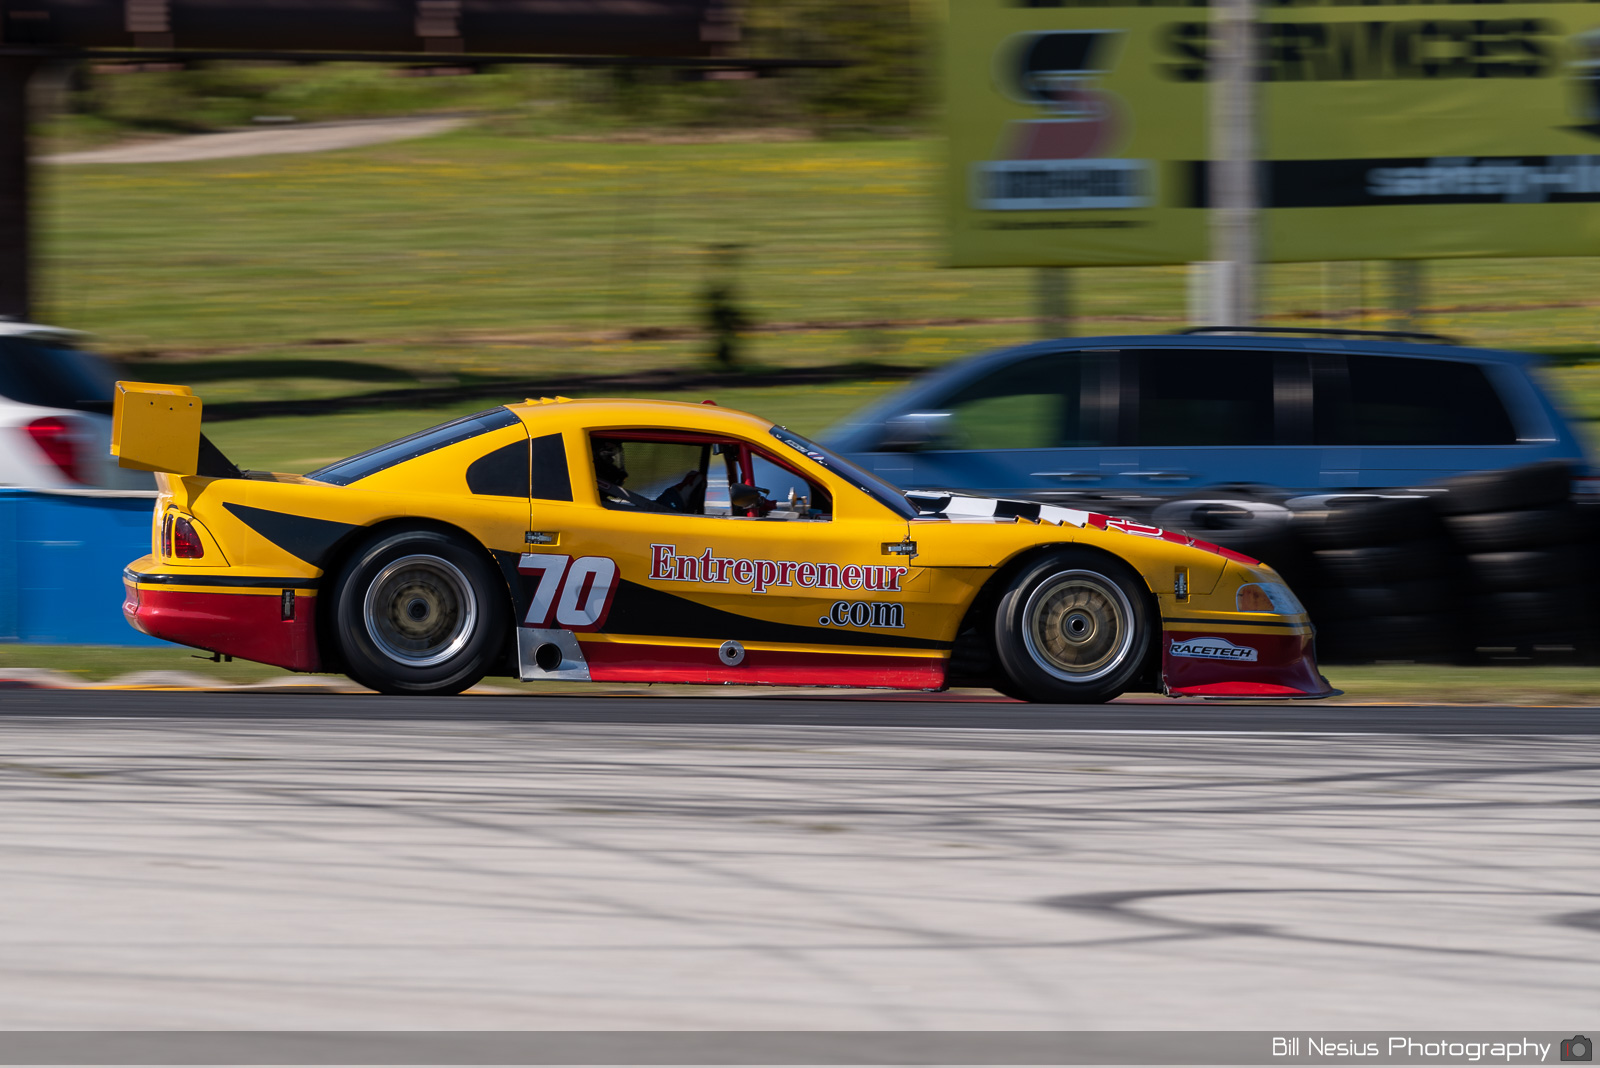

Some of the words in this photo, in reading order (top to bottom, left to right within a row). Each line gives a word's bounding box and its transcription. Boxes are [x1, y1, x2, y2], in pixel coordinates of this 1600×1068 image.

[1154, 18, 1558, 83] SRVICES
[517, 552, 620, 632] 70
[649, 543, 908, 594] Entrepreneur
[818, 600, 906, 629] .com
[1170, 644, 1252, 657] RACETECH
